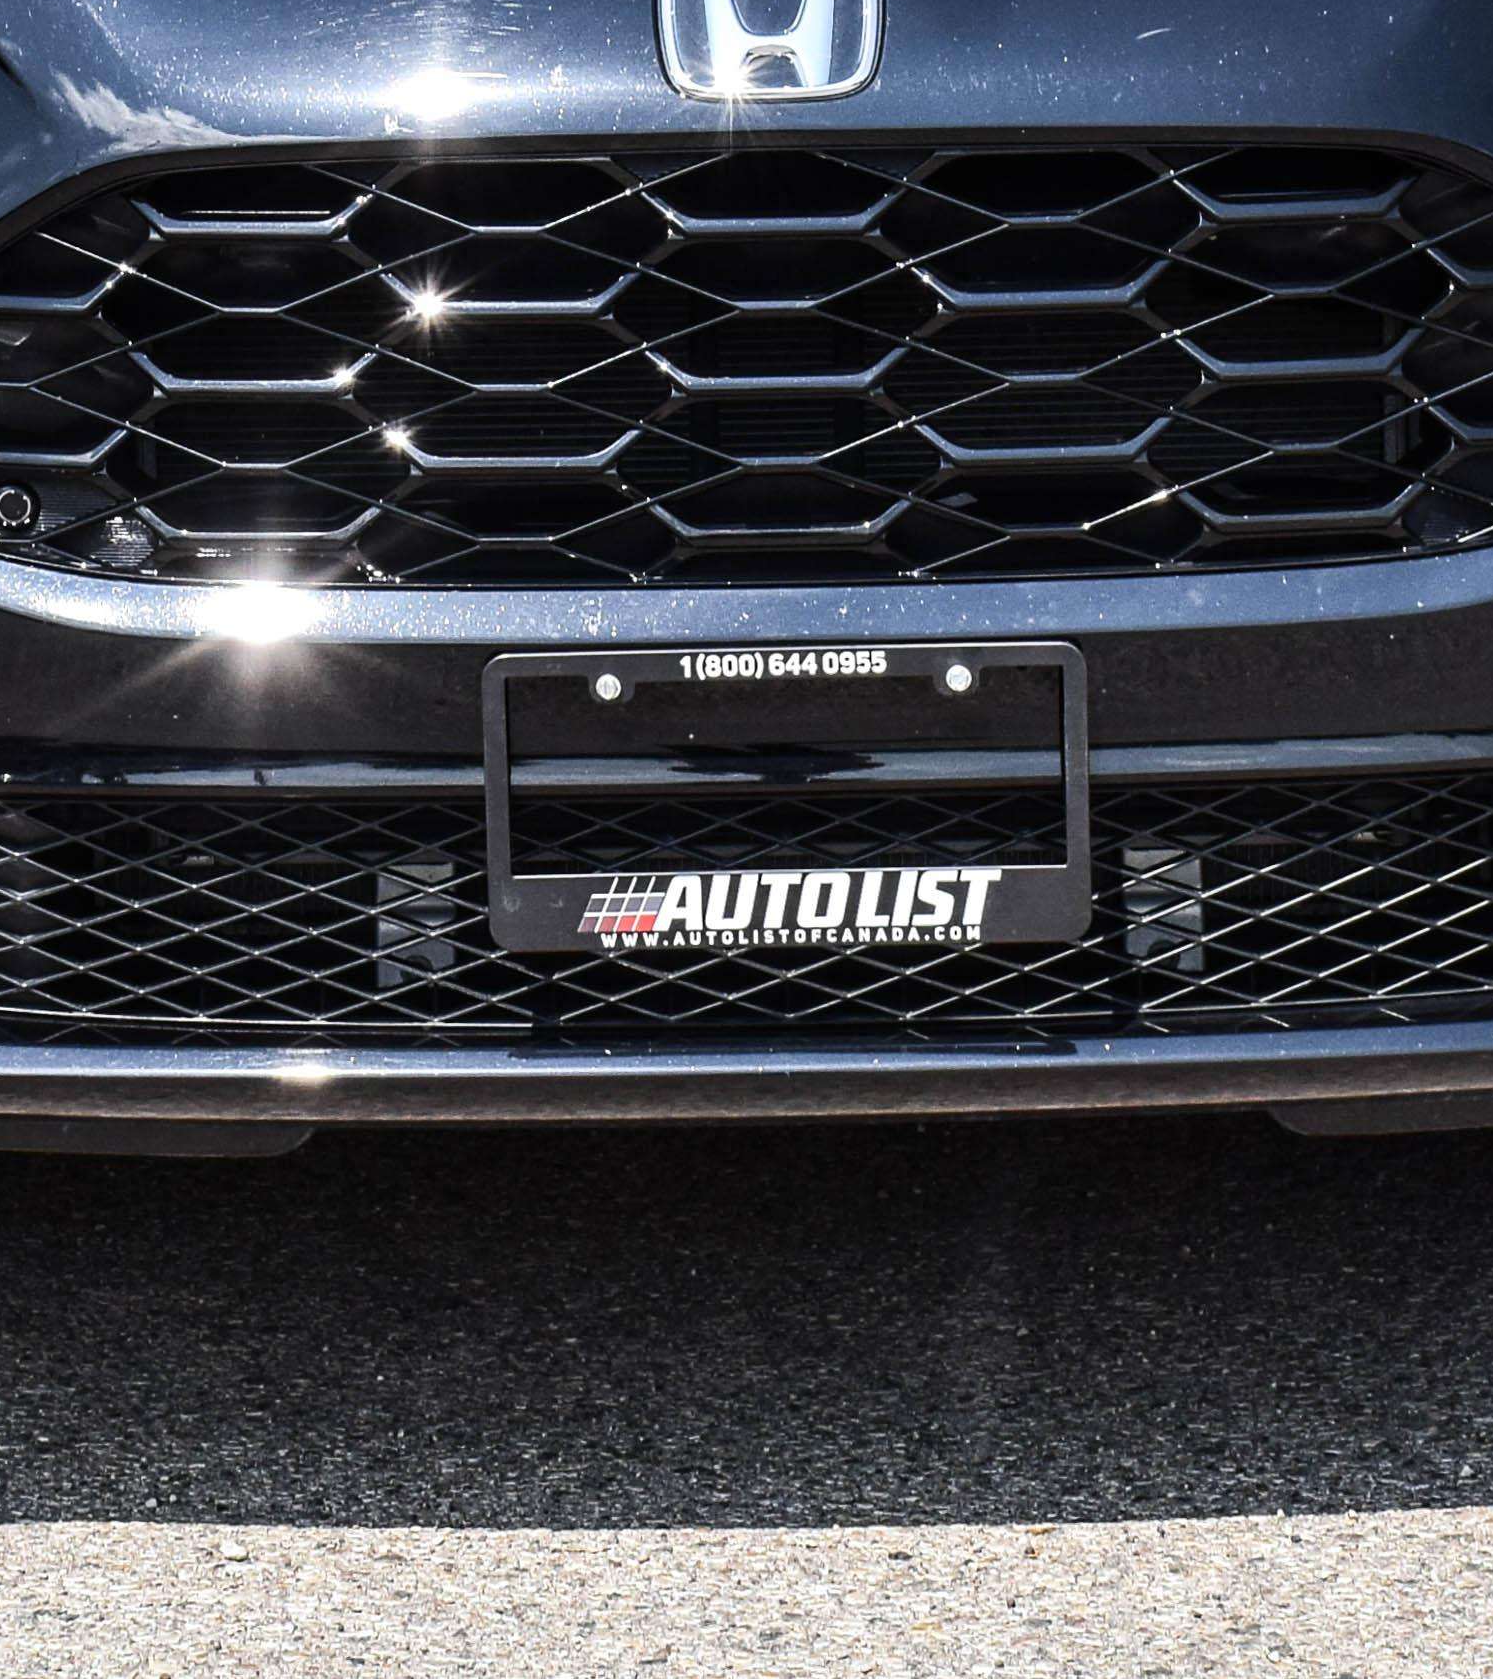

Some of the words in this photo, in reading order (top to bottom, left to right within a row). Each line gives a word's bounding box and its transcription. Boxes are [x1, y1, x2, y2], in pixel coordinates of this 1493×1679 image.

[768, 652, 818, 676] 644
[822, 650, 888, 675] 0955
[600, 925, 982, 949] WWW.AUTOLISTOFCANADA.COM
